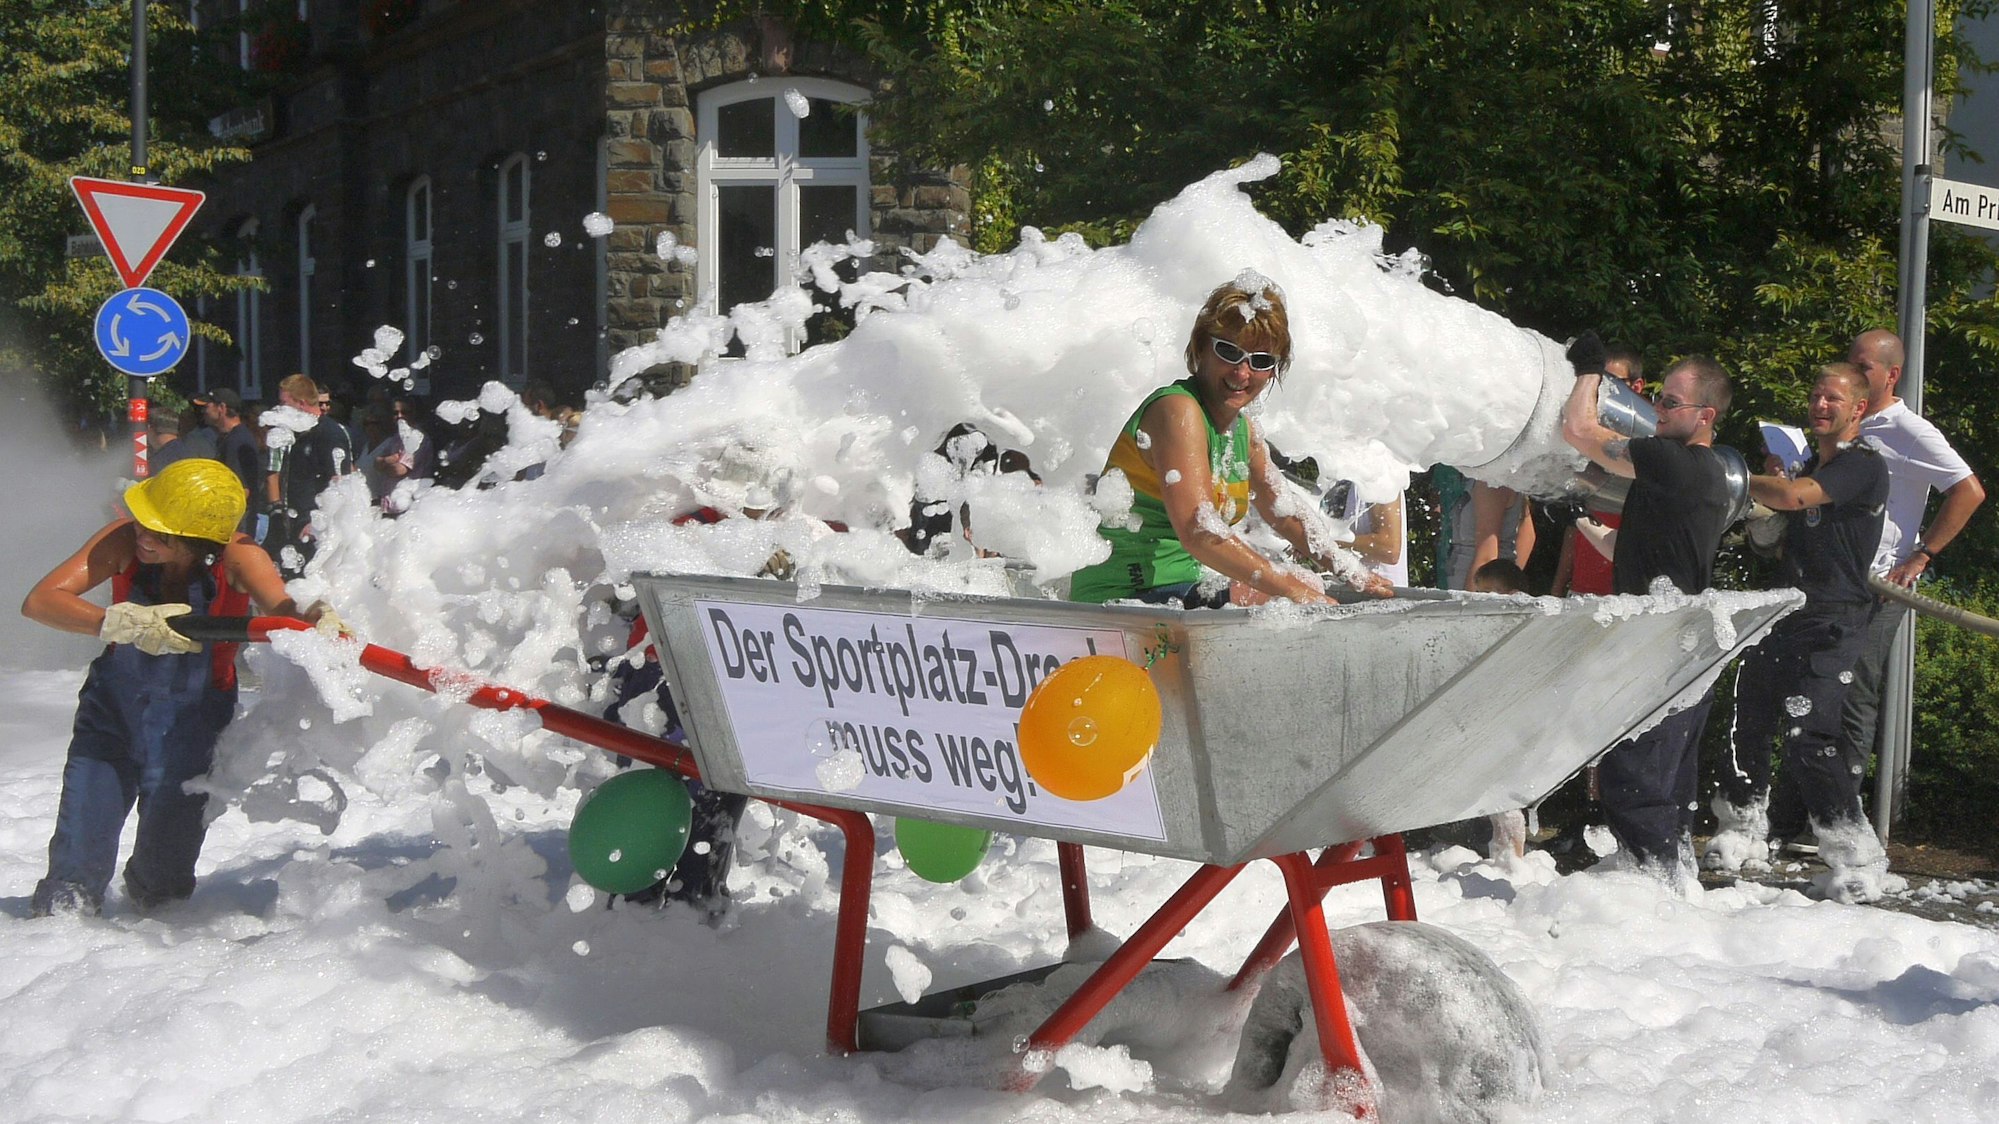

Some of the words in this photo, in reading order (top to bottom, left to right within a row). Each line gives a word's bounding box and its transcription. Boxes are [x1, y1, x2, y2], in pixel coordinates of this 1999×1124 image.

[1942, 188, 1969, 216] Am
[707, 607, 782, 684] Der
[782, 611, 1097, 717] Sportplatz-Dr
[824, 719, 933, 784] muss
